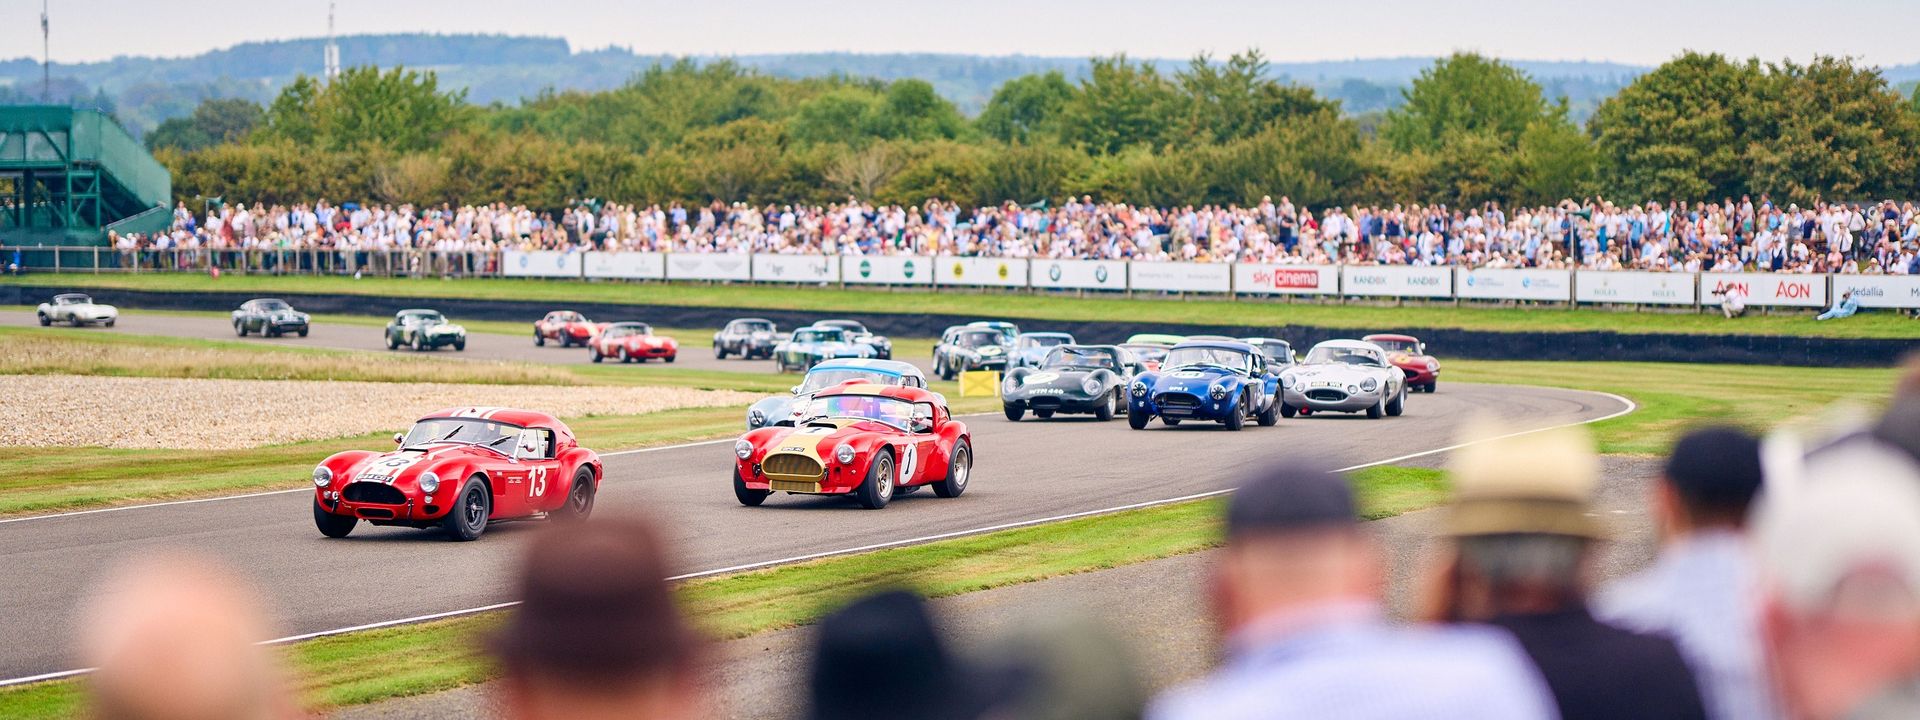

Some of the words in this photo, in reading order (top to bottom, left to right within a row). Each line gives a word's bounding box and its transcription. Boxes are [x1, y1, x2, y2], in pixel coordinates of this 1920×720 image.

[1253, 270, 1271, 286] sky
[1276, 271, 1317, 286] cinema
[1353, 275, 1387, 285] RANDOX
[1407, 276, 1441, 286] RANDOX
[1775, 281, 1810, 298] AON
[378, 457, 410, 467] 13
[904, 448, 912, 475] 1
[528, 465, 547, 497] 13
